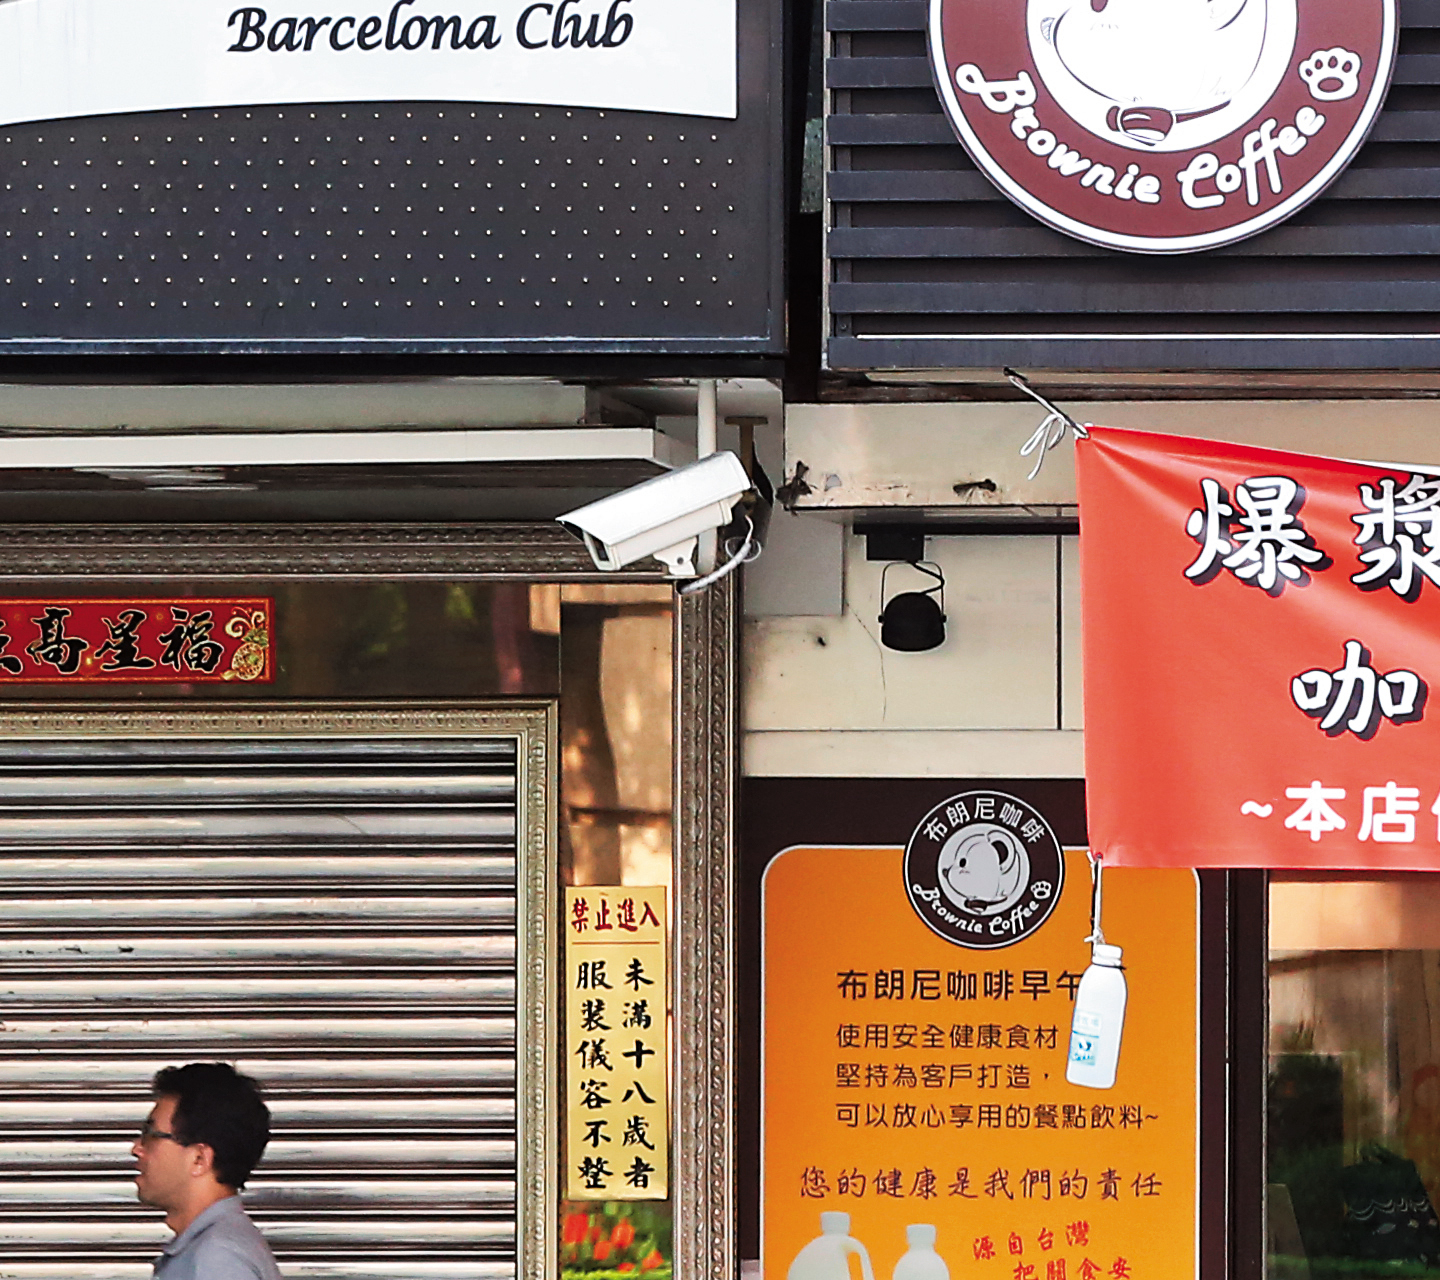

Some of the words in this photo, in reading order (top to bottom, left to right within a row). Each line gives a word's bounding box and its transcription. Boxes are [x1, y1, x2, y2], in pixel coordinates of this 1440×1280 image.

[956, 63, 1160, 202] Brownie
[1177, 106, 1325, 209] Coffee
[923, 797, 1046, 845] 布朗尼咖啡
[571, 897, 660, 933] 禁止進入
[913, 883, 983, 934] Brownie
[989, 900, 1039, 936] Coffee
[836, 1024, 1059, 1049] 使用安全健康食材
[575, 960, 614, 1189] 服裝儀容不整
[622, 958, 656, 1189] 未滿十八歲者
[800, 1167, 1163, 1200] 您的健康是我們的責任
[973, 1221, 1091, 1260] 源自台灣
